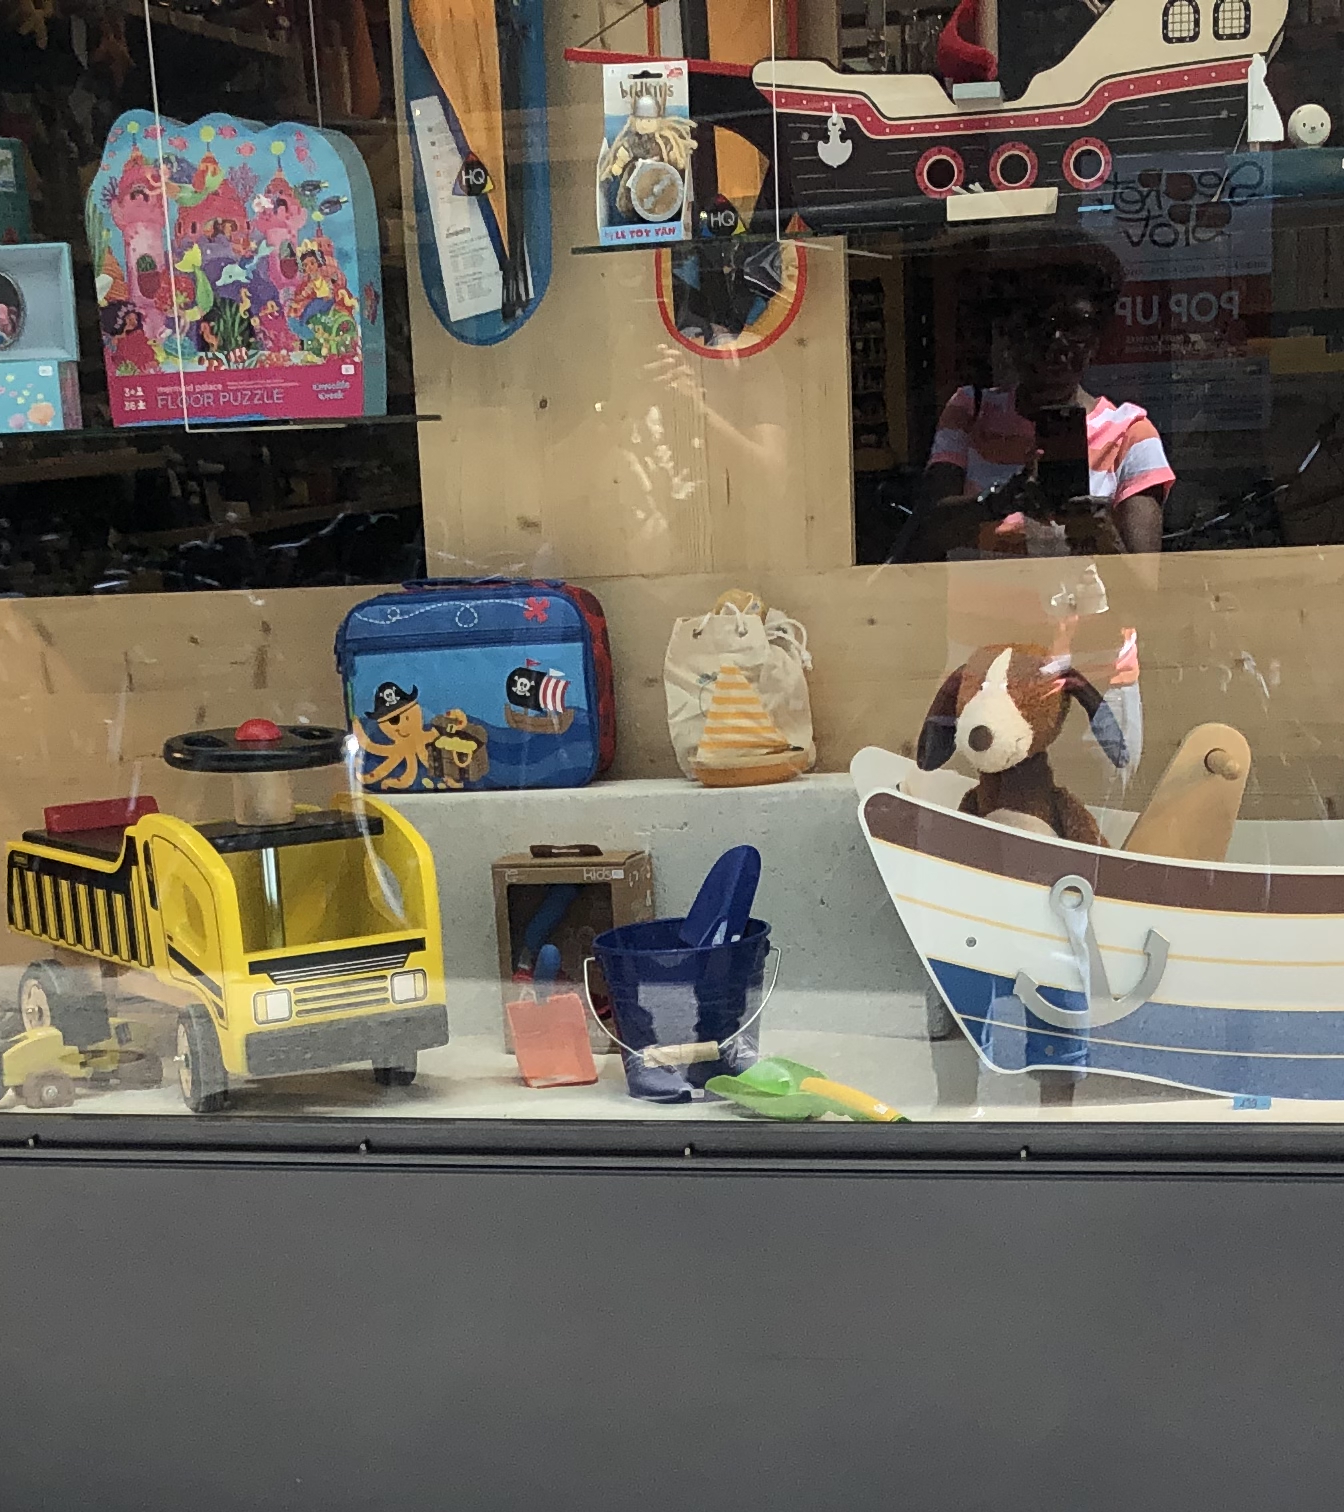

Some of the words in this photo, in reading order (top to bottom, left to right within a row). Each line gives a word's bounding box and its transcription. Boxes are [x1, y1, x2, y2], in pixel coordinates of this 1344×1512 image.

[461, 168, 486, 186] HQ
[710, 210, 735, 228] HQ
[630, 228, 651, 238] TOY
[157, 392, 214, 409] FLOOR
[220, 388, 285, 406] PUZZLE
[583, 868, 611, 881] kids
